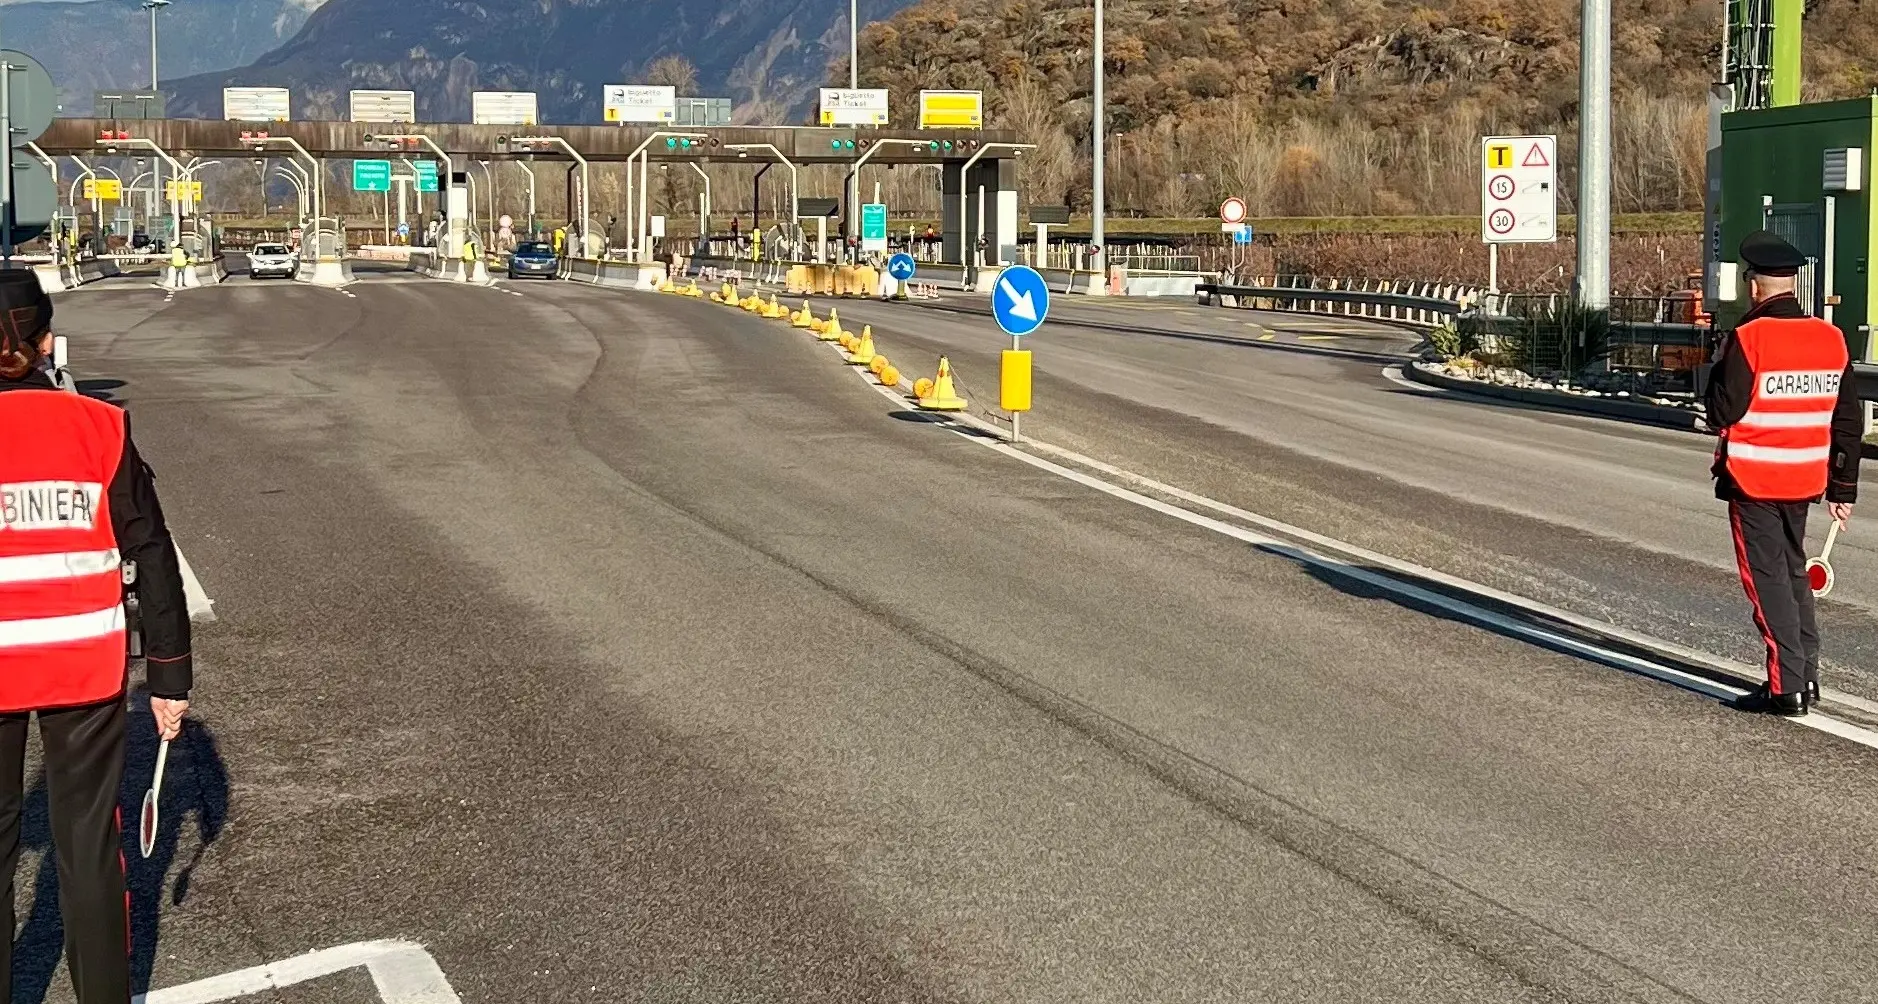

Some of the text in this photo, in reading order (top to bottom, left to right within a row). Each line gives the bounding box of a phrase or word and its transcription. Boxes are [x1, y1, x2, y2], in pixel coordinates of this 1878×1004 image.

[823, 111, 831, 121] T
[1492, 146, 1509, 166] T
[1496, 181, 1508, 194] 15
[1495, 215, 1509, 227] 30
[1766, 373, 1840, 395] CARABINIER
[0, 487, 93, 523] BINIERI
